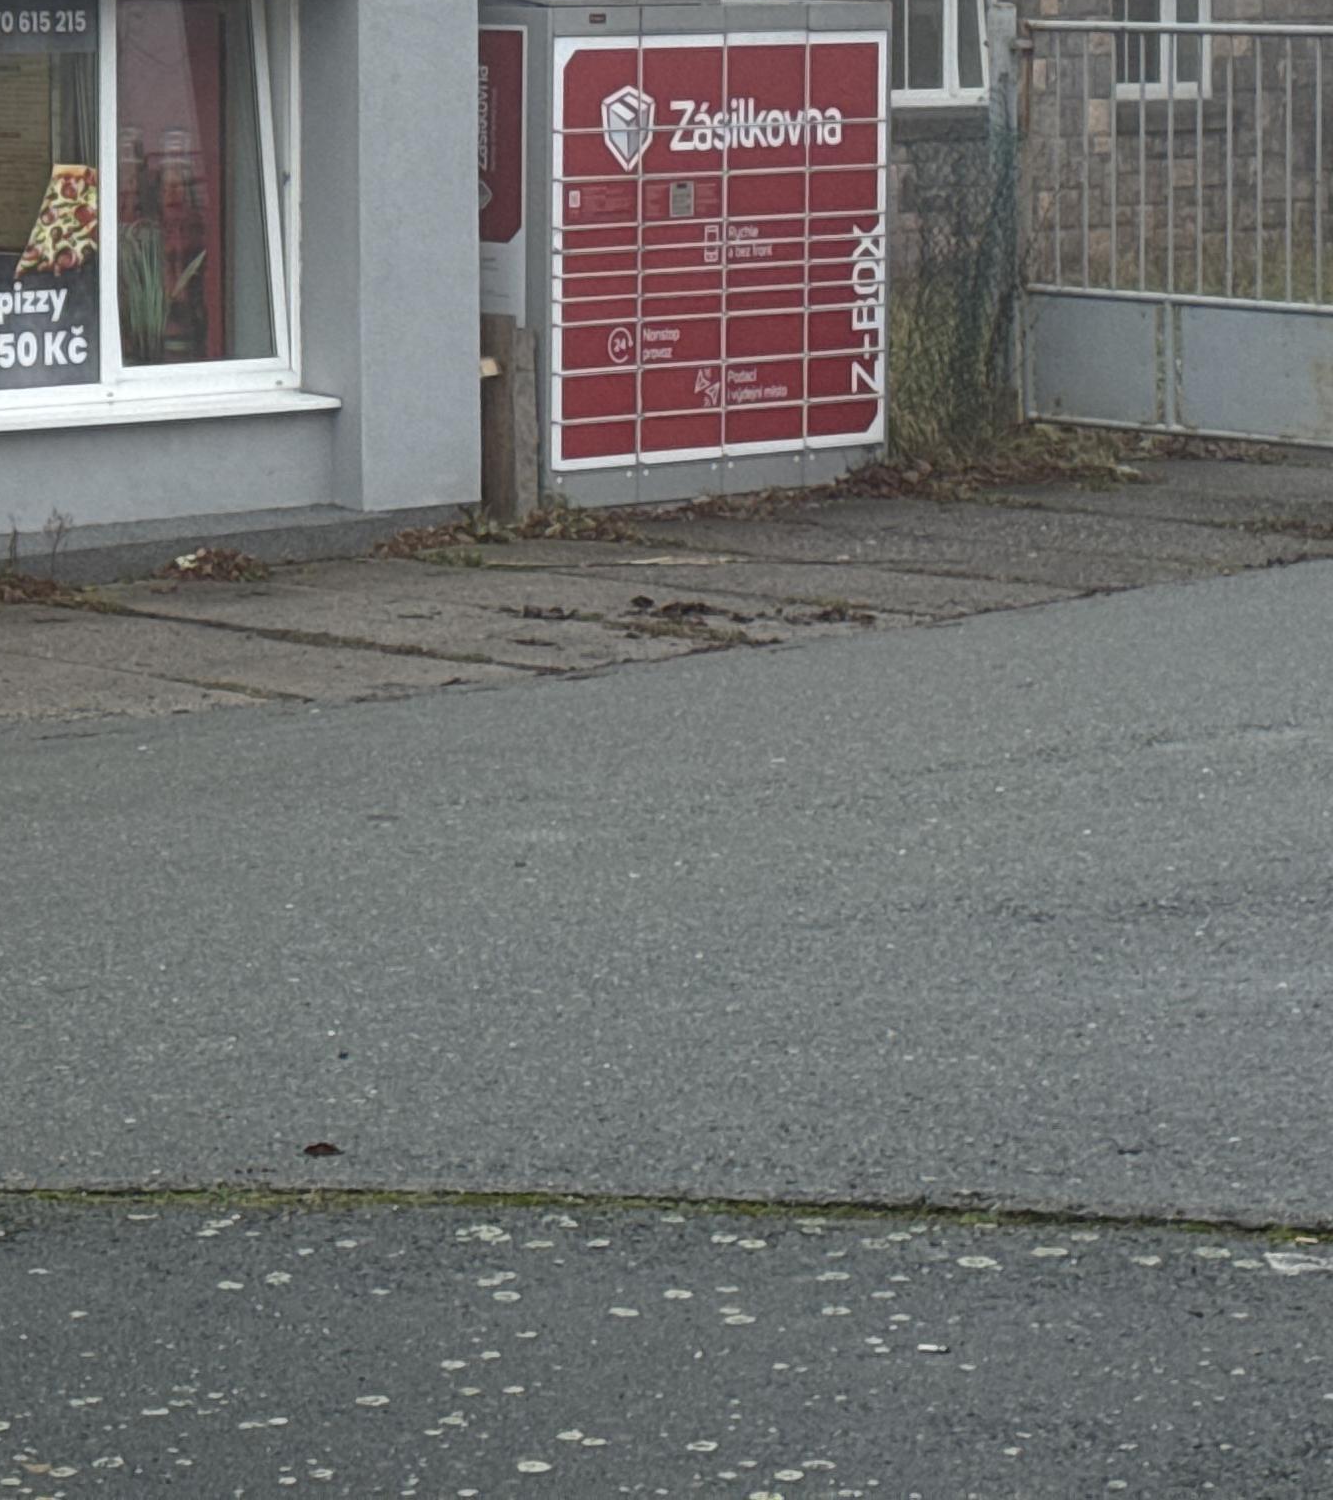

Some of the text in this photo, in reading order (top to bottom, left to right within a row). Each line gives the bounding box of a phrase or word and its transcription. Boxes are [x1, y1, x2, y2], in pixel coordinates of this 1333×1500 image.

[18, 10, 51, 33] 615
[55, 9, 88, 33] 215
[669, 97, 842, 151] Zásilkovna
[852, 224, 883, 393] Z-BOX
[43, 325, 88, 366] Kč
[613, 337, 627, 353] 24
[643, 328, 680, 342] Nonstop
